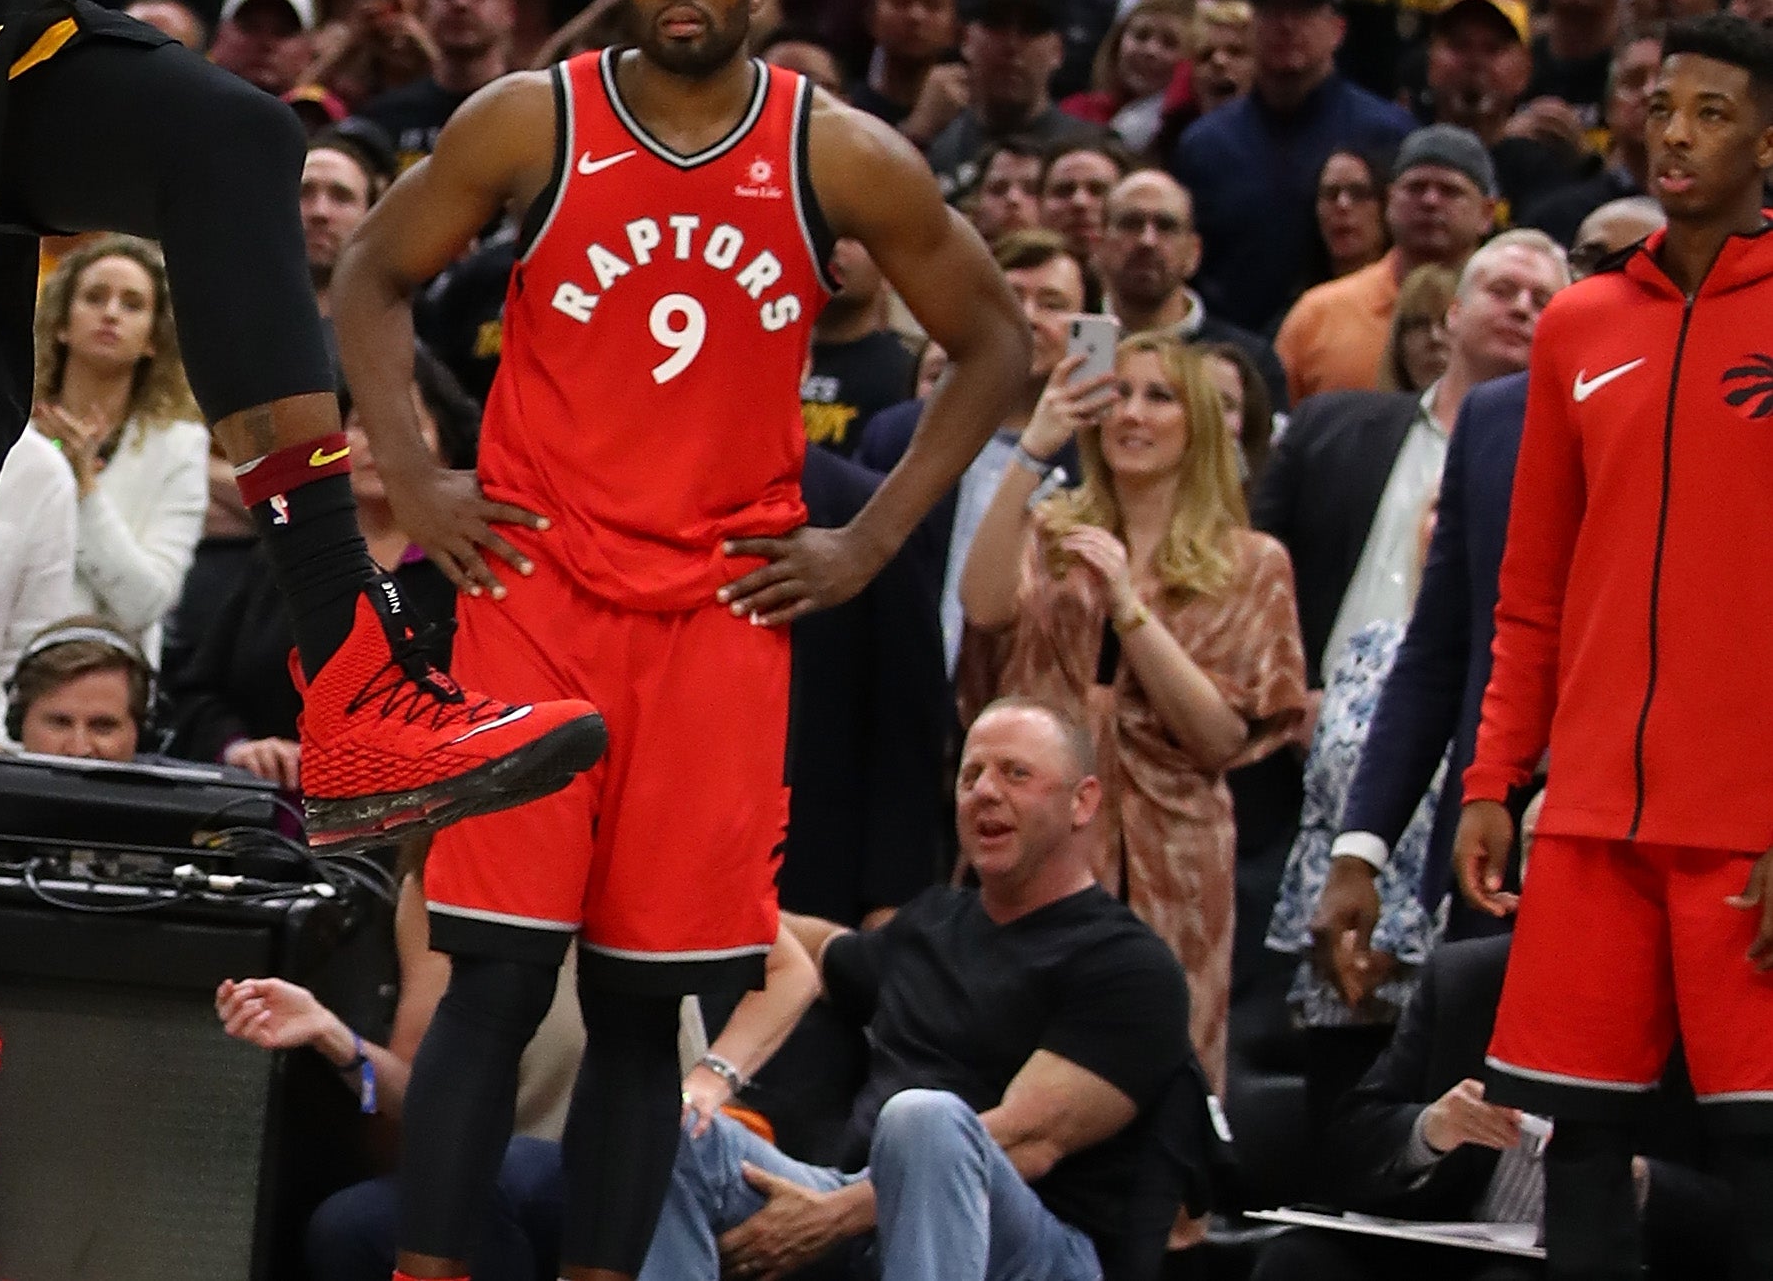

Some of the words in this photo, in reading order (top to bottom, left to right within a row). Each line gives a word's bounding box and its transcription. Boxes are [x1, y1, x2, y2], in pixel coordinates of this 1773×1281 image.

[551, 214, 803, 333] RAPTORS
[648, 292, 708, 386] 9
[381, 581, 402, 615] NIKE
